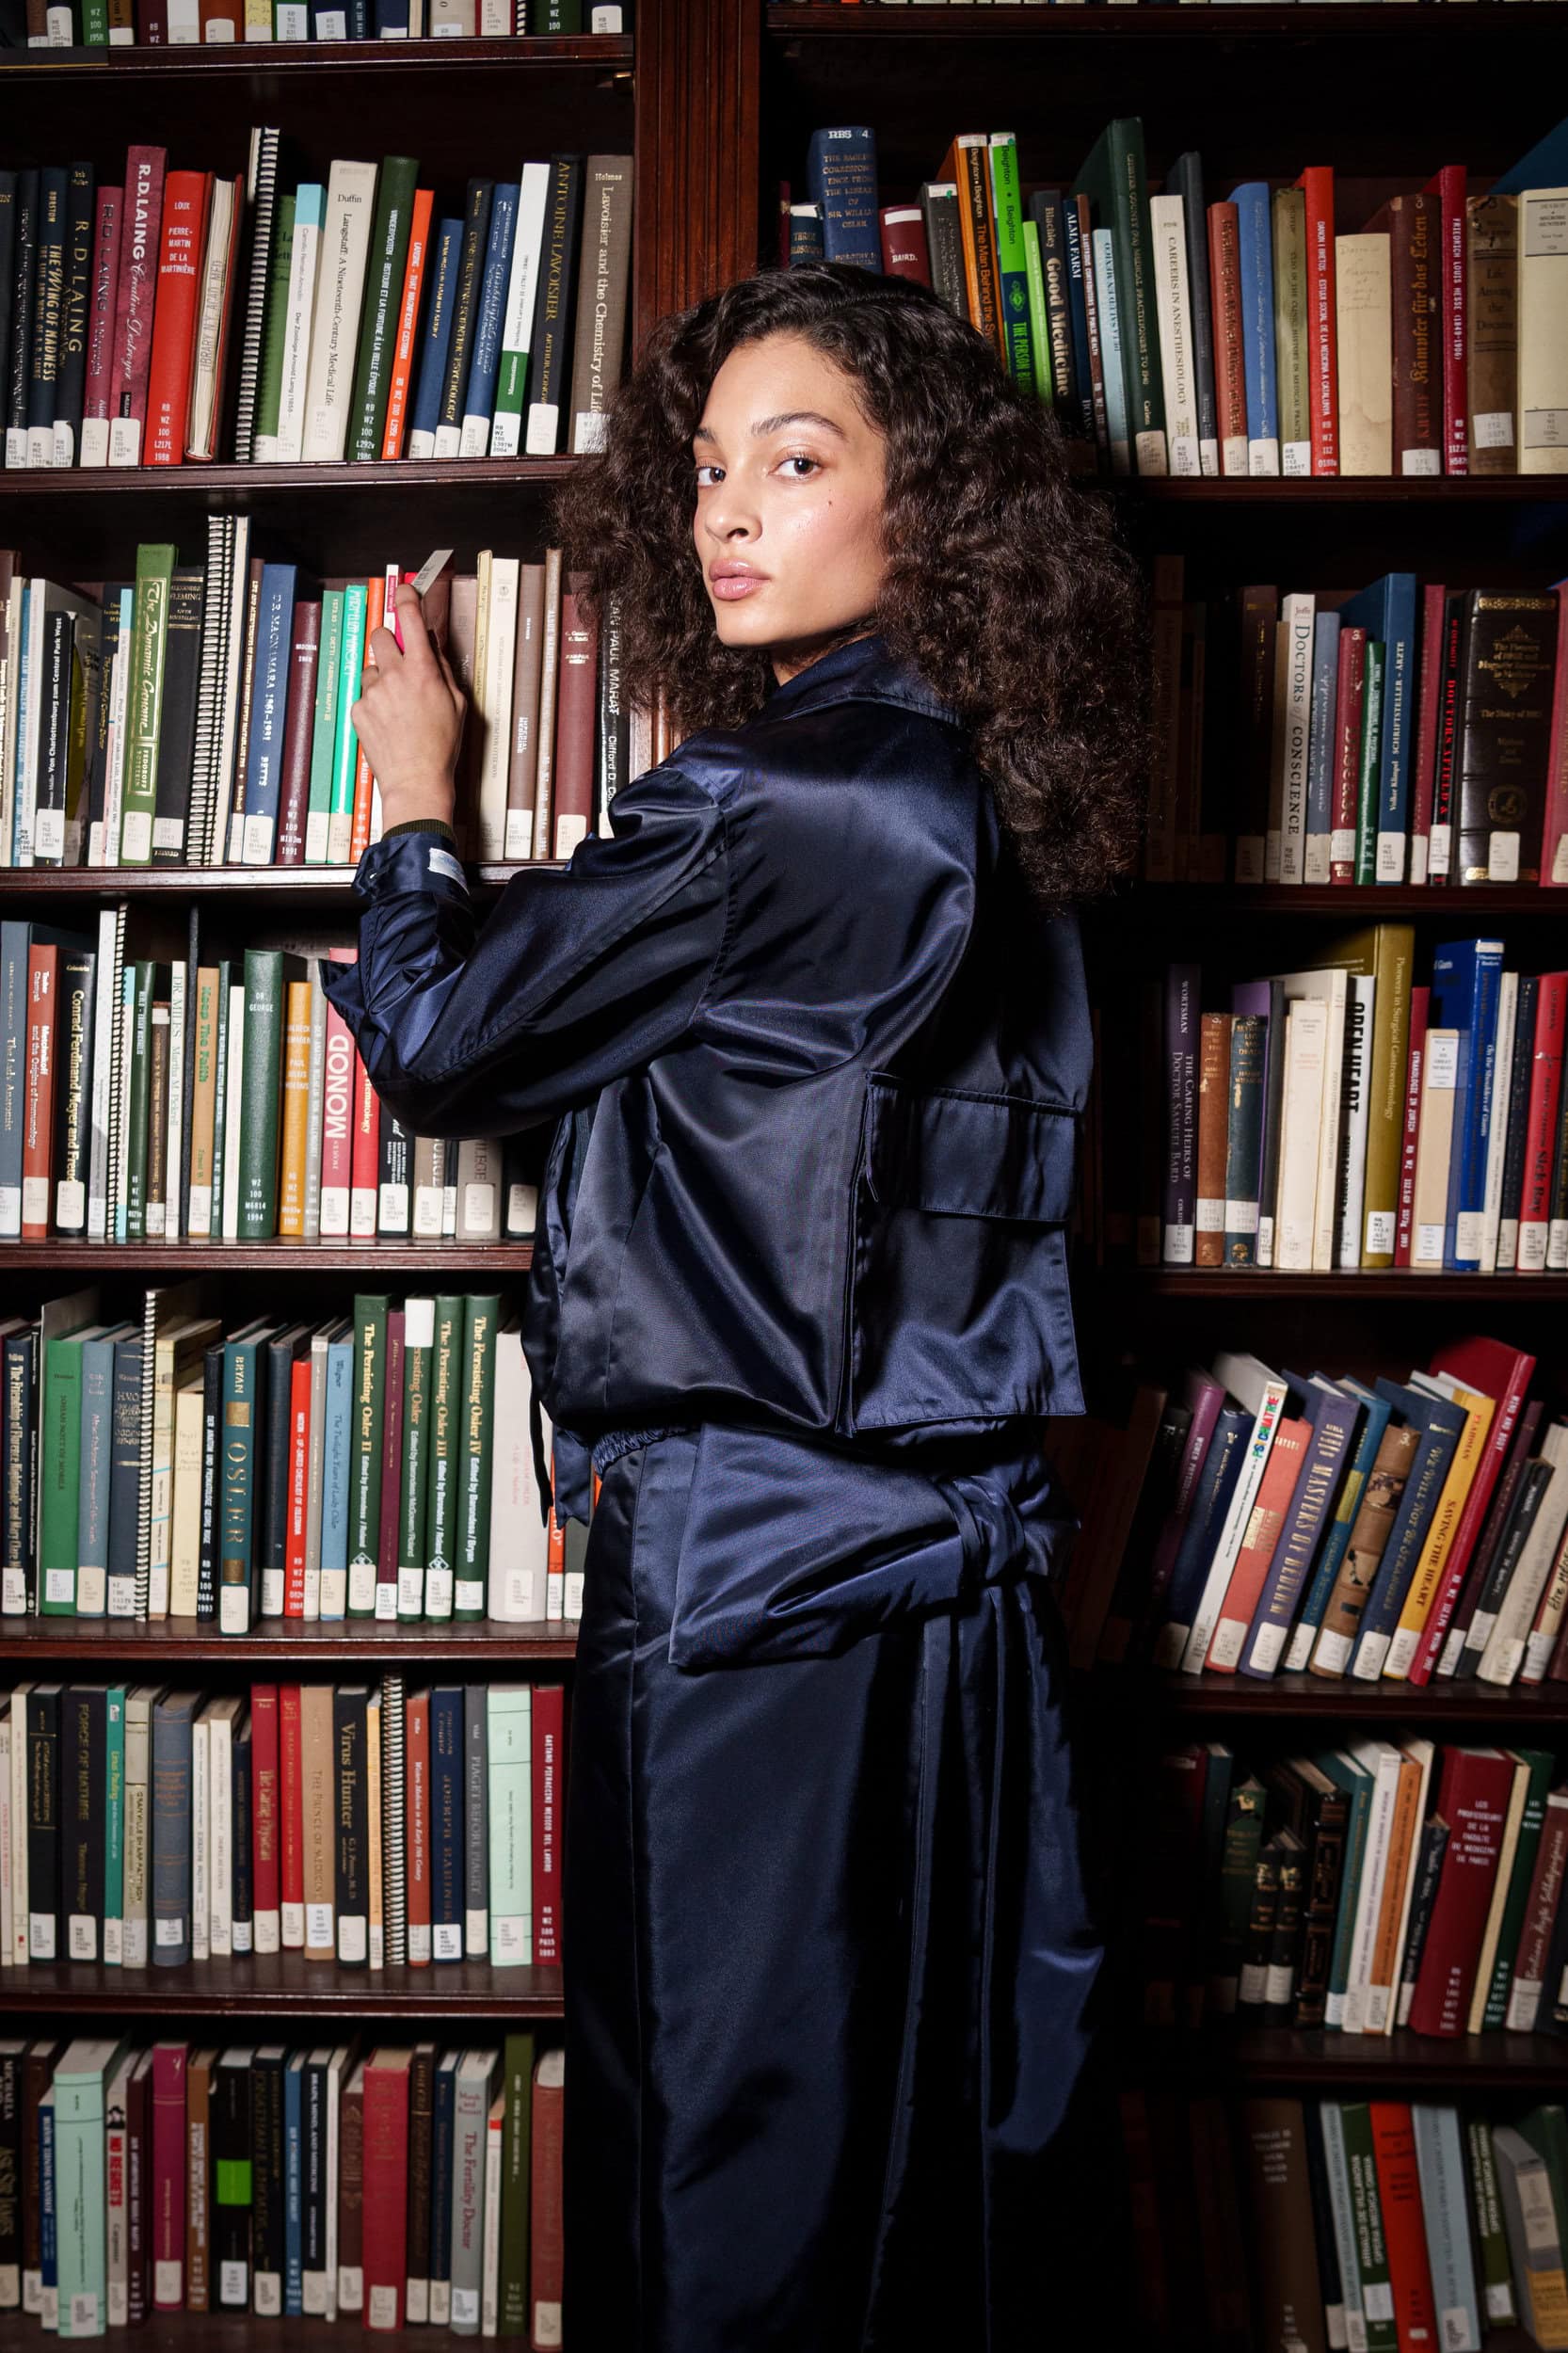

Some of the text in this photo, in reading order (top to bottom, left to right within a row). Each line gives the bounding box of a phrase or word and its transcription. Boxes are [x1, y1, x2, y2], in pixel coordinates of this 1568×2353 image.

[827, 129, 870, 139] RBS 4
[595, 172, 623, 182] Holmes
[1001, 146, 1016, 245] Beighton Beighton
[338, 195, 362, 203] Duffin
[600, 186, 615, 247] Lavoisier
[168, 239, 191, 248] MARTIN
[545, 161, 570, 322] ANTOINE LAVOISIER
[977, 224, 986, 242] The
[1066, 212, 1082, 279] ALMA FARM
[1453, 217, 1462, 258] FRIEDRICH
[48, 245, 62, 265] THE
[179, 253, 187, 262] LA
[340, 257, 347, 265] A
[598, 248, 610, 275] and
[892, 253, 919, 264] BAIRD.
[978, 244, 989, 266] Man
[1453, 261, 1462, 283] LOUIS
[129, 263, 146, 316] Creative
[596, 278, 609, 300] the
[981, 268, 994, 304] Behind
[1046, 256, 1065, 308] Good
[1453, 287, 1463, 311] HESSE
[45, 311, 59, 326] OF
[200, 333, 214, 373] LIBRARY
[209, 260, 223, 280] MED
[590, 301, 608, 373] Chemistry
[1168, 236, 1187, 406] CAREERS IN ANESTHESIOLOGY
[41, 328, 58, 381] MADNESS
[120, 317, 143, 380] Destroyer
[1012, 322, 1031, 374] THE PERSON
[1049, 312, 1071, 396] Medicine
[328, 352, 339, 390] Medical
[591, 375, 603, 389] of
[325, 390, 334, 406] Life
[363, 416, 375, 424] WZ
[54, 634, 62, 651] Park
[141, 611, 158, 677] Dynamic
[53, 652, 61, 682] Central
[609, 629, 621, 716] PAUL MARAT
[49, 698, 59, 757] Charlottenburg
[140, 749, 149, 789] FEDOROFF
[607, 735, 617, 770] Clifford
[1288, 726, 1304, 835] CONSCIENCE
[1395, 956, 1406, 995] Pioneers
[72, 989, 85, 1032] Conrad
[1180, 980, 1190, 1034] WORTSMAN
[1391, 1007, 1402, 1044] Surgical
[31, 1042, 40, 1055] the
[199, 985, 212, 1082] Keep The Faith
[30, 1057, 39, 1085] Origins
[69, 1032, 84, 1092] Ferdinand
[325, 1034, 349, 1139] MONOD
[1384, 1045, 1400, 1121] Gastroenterology
[27, 1098, 39, 1150] Immunology
[66, 1093, 82, 1127] Meyer
[360, 1077, 373, 1134] ematology
[1182, 1053, 1193, 1180] THE CARING HEIRS OF
[67, 1127, 80, 1149] and
[233, 1355, 245, 1394] BRYAN
[360, 1322, 375, 1452] The Persisting Osler II
[435, 1320, 452, 1457] The Persisting Osler III
[469, 1316, 487, 1456] The Persisting Osler IV
[410, 1393, 423, 1425] Osler
[470, 1457, 480, 1482] Edited
[226, 1442, 248, 1544] OSLER
[1295, 1463, 1334, 1532] MASTERS
[1436, 1498, 1457, 1541] SAVING
[1269, 1556, 1304, 1614] BEDLAM
[1416, 1562, 1436, 1607] HEART
[77, 1703, 90, 1821] FORCE OF NATURE
[544, 1734, 553, 1763] GAETANO
[312, 1770, 323, 1790] THE
[341, 1721, 357, 1830] Virus Hunter
[471, 1755, 482, 1895] PIAGET BEFORE PIAGET
[543, 1833, 552, 1846] DEL
[544, 1806, 553, 1832] MEDICO
[543, 1848, 552, 1873] LAVORO
[460, 2131, 478, 2250] The Fertility Doctor
